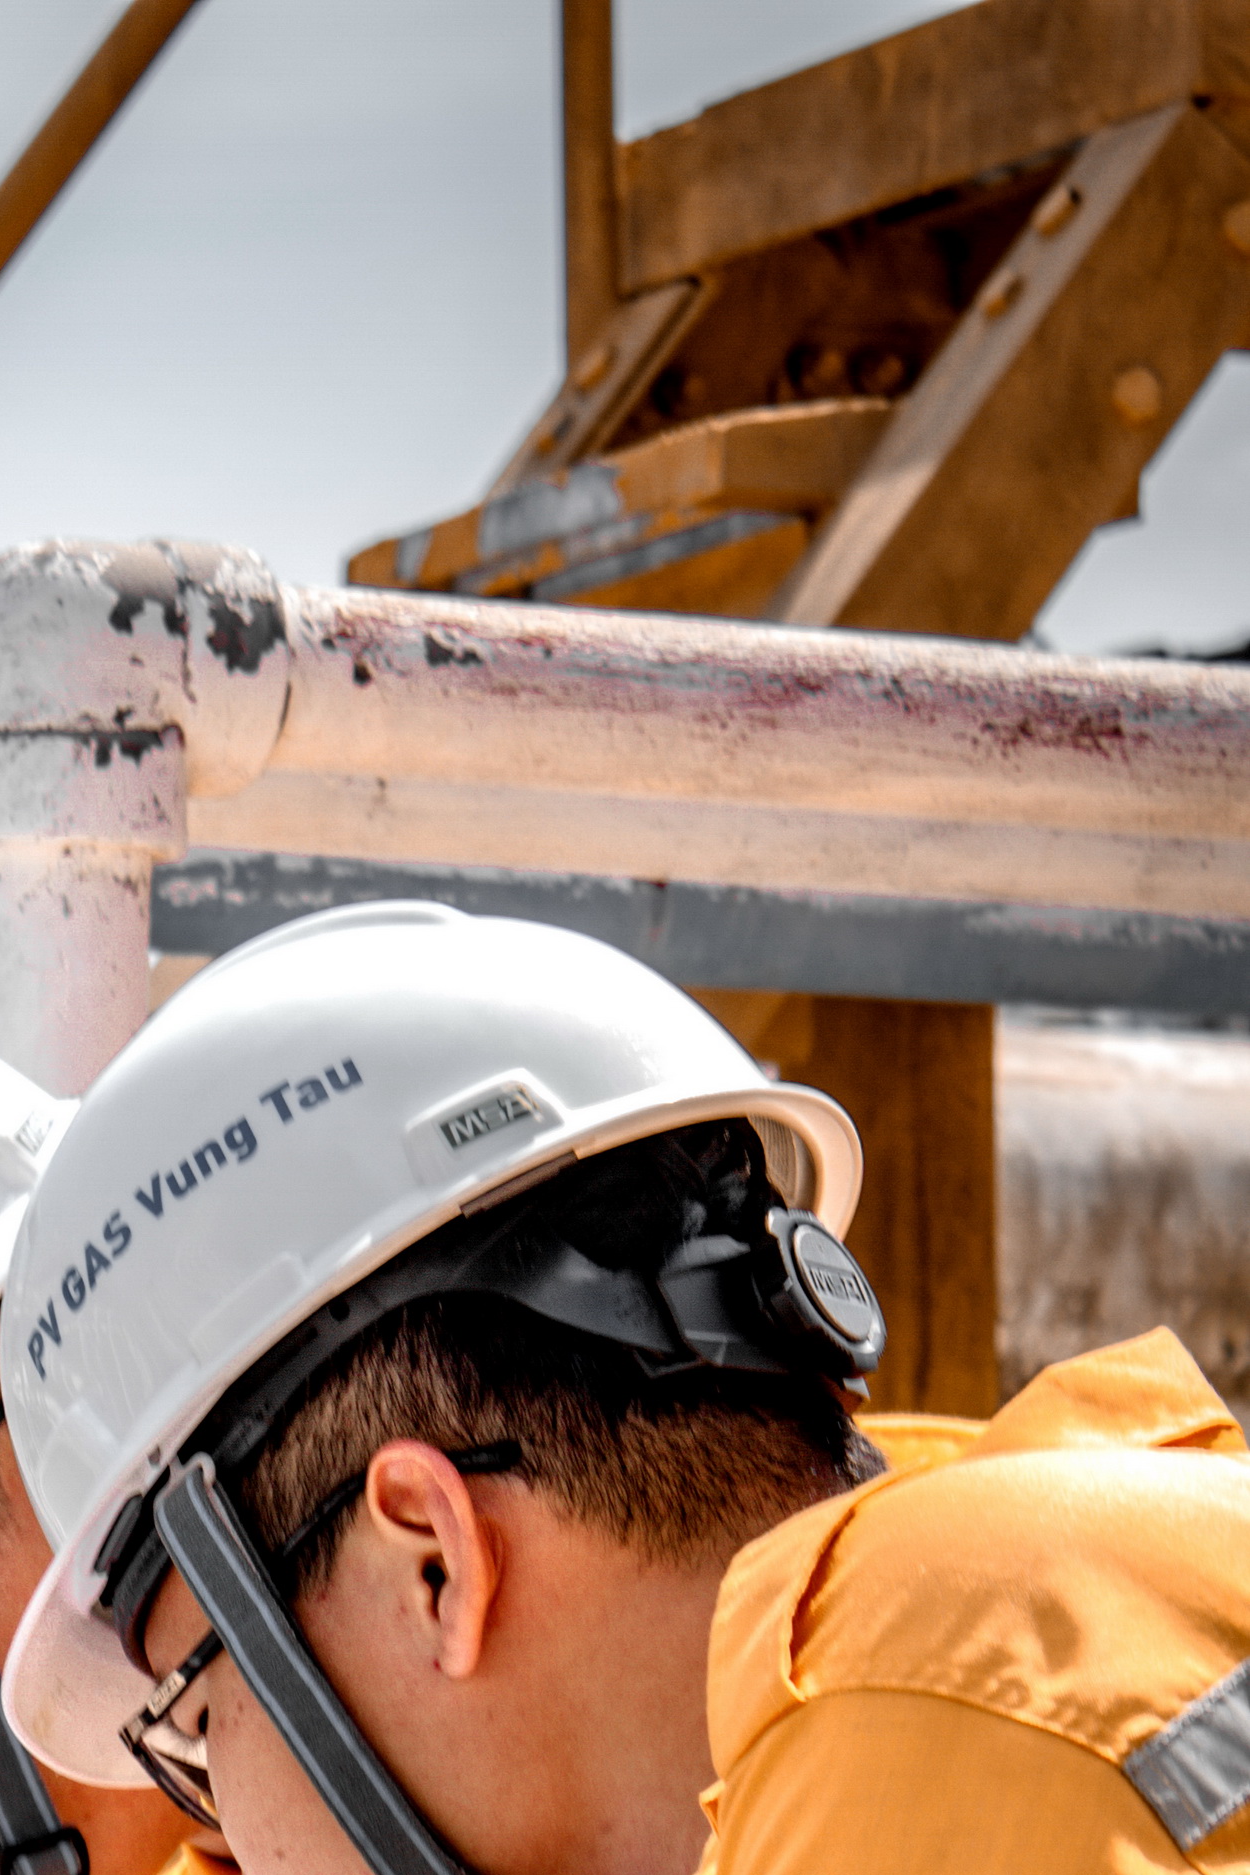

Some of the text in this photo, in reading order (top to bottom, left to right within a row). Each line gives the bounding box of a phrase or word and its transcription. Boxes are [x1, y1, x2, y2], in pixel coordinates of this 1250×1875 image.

[26, 1295, 64, 1380] PV
[61, 1208, 134, 1313] GAS
[135, 1115, 261, 1219] Vung
[260, 1055, 365, 1125] Tau
